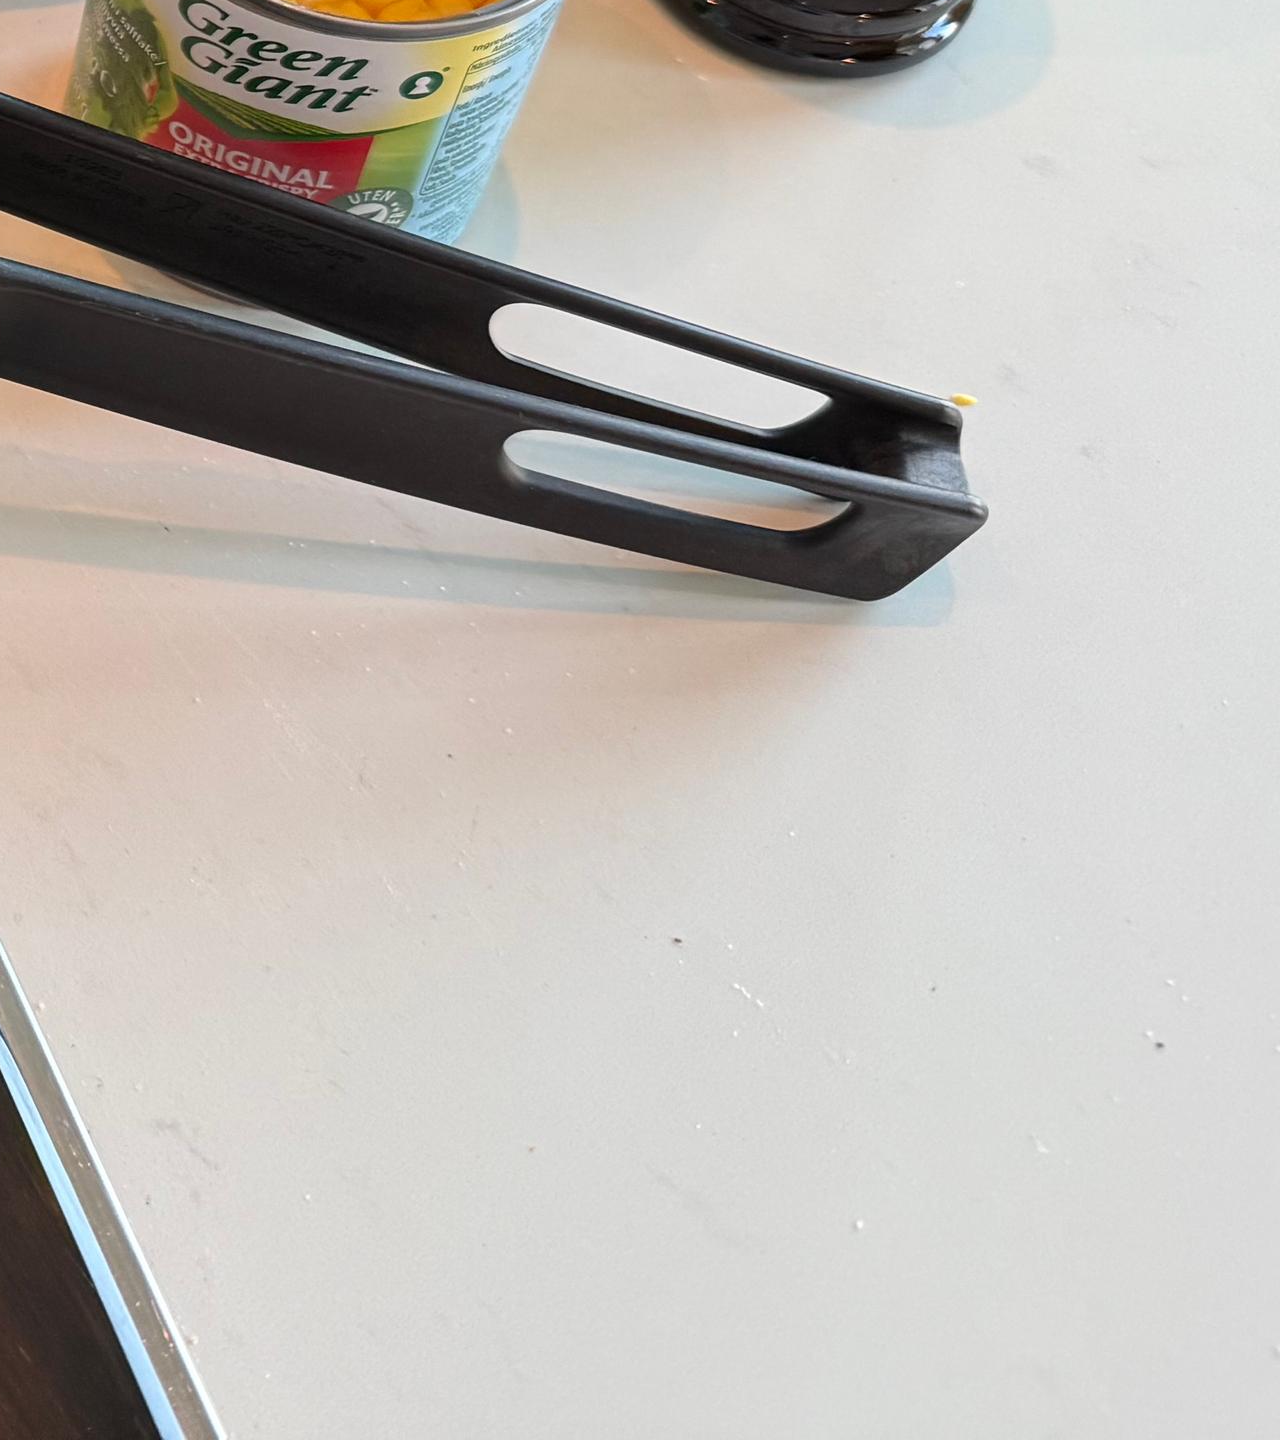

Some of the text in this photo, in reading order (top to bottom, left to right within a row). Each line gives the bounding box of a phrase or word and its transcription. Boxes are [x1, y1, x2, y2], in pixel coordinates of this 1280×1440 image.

[180, 35, 373, 114] Giant
[168, 121, 334, 190] ORIGINAL
[347, 189, 397, 205] UTEN
